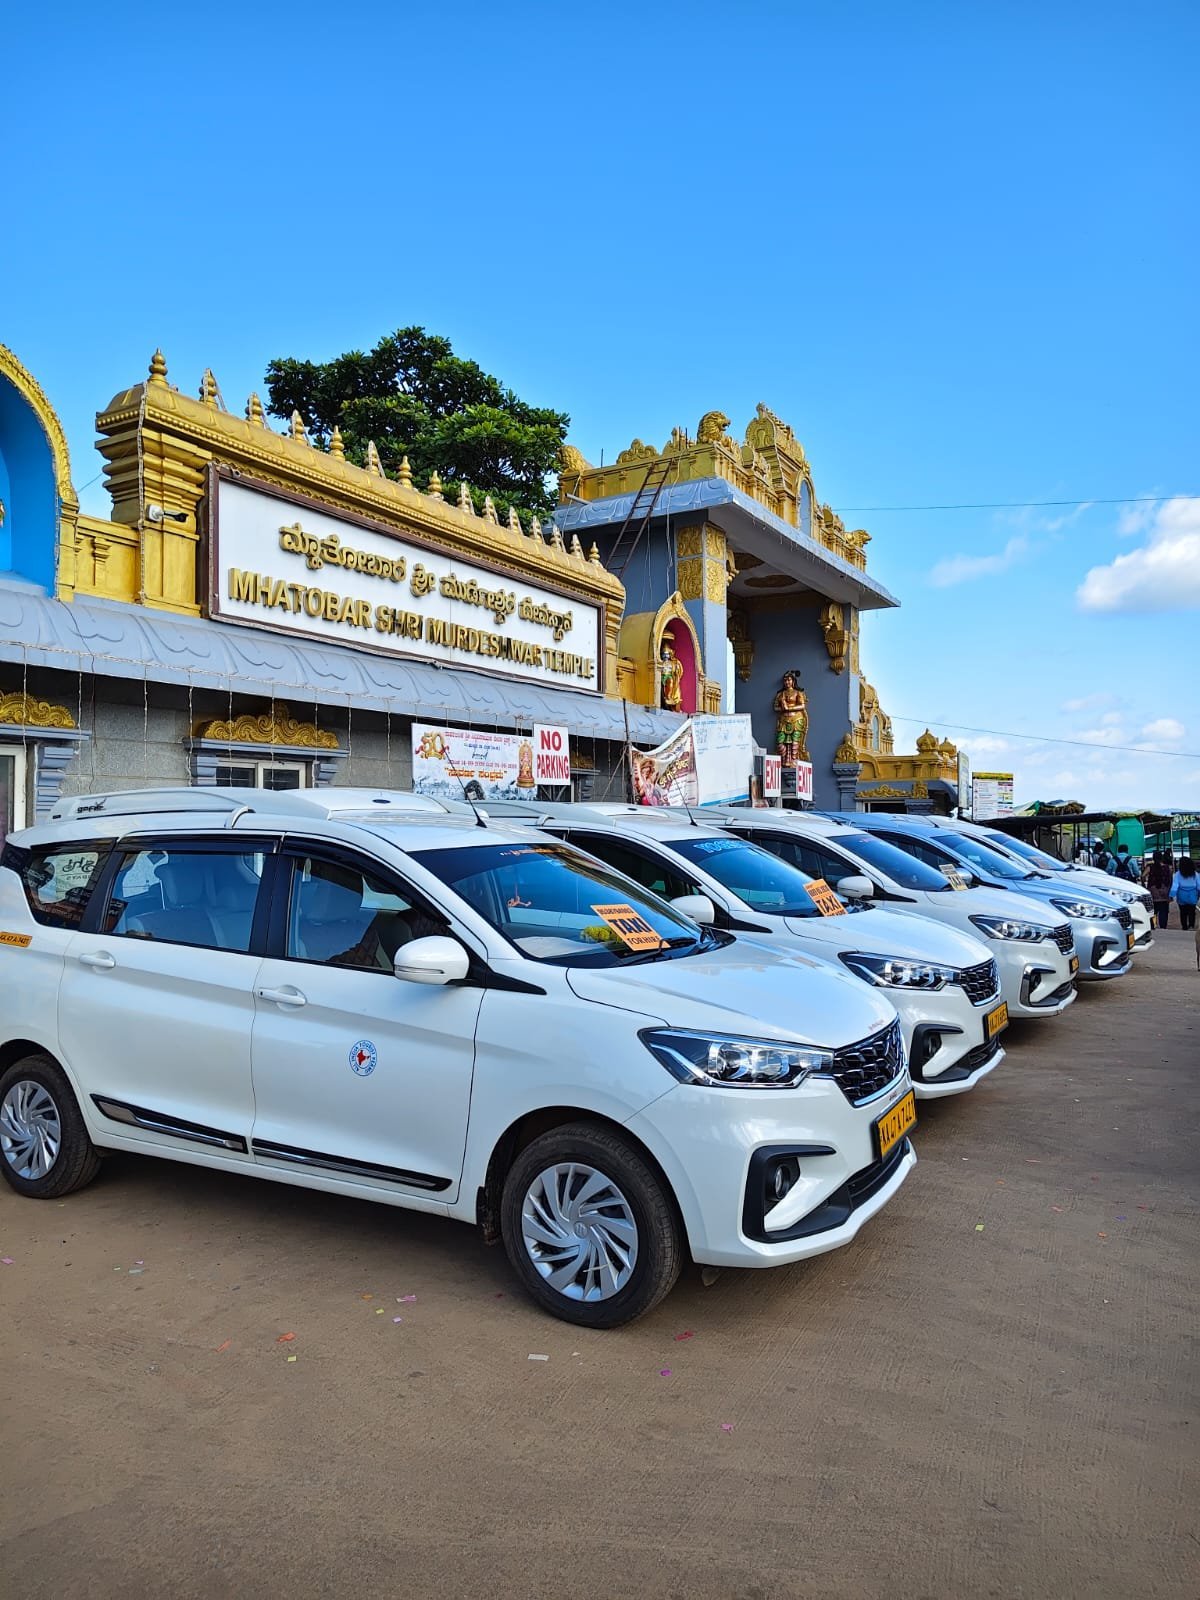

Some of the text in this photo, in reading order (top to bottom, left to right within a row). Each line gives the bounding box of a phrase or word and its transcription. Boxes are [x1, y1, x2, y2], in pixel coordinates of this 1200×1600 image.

[410, 563, 436, 597] ಶ್ರೀ
[228, 567, 595, 679] MHATOBAR SHRI MURDESHWAR TEMPLE
[540, 730, 562, 751] NO
[537, 753, 570, 780] PARKING
[765, 759, 782, 790] EXIT
[798, 765, 812, 794] EXIT
[608, 917, 652, 935] TAXI
